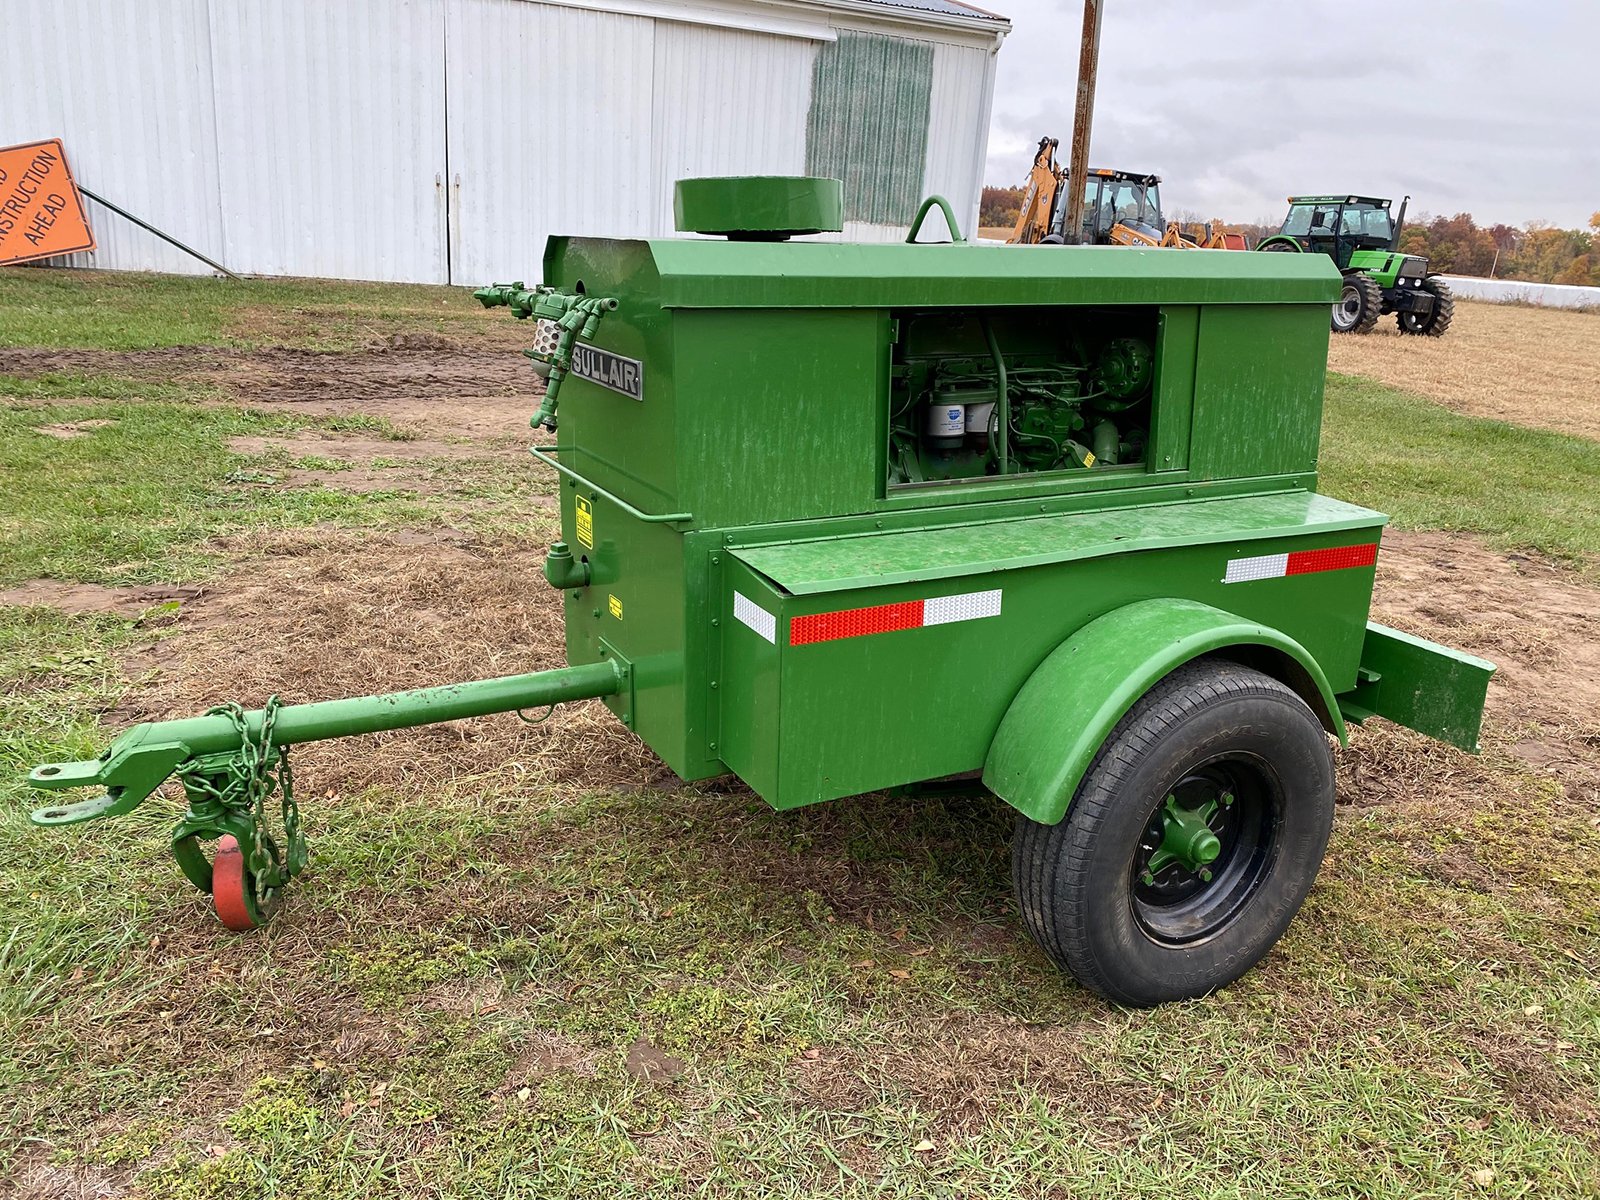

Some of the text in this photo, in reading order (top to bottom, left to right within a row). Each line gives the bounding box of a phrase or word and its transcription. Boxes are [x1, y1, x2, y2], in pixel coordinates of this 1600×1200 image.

[0, 149, 57, 246] NSTRUCTION
[23, 193, 66, 246] AHEAD
[572, 346, 637, 394] SULLAIR
